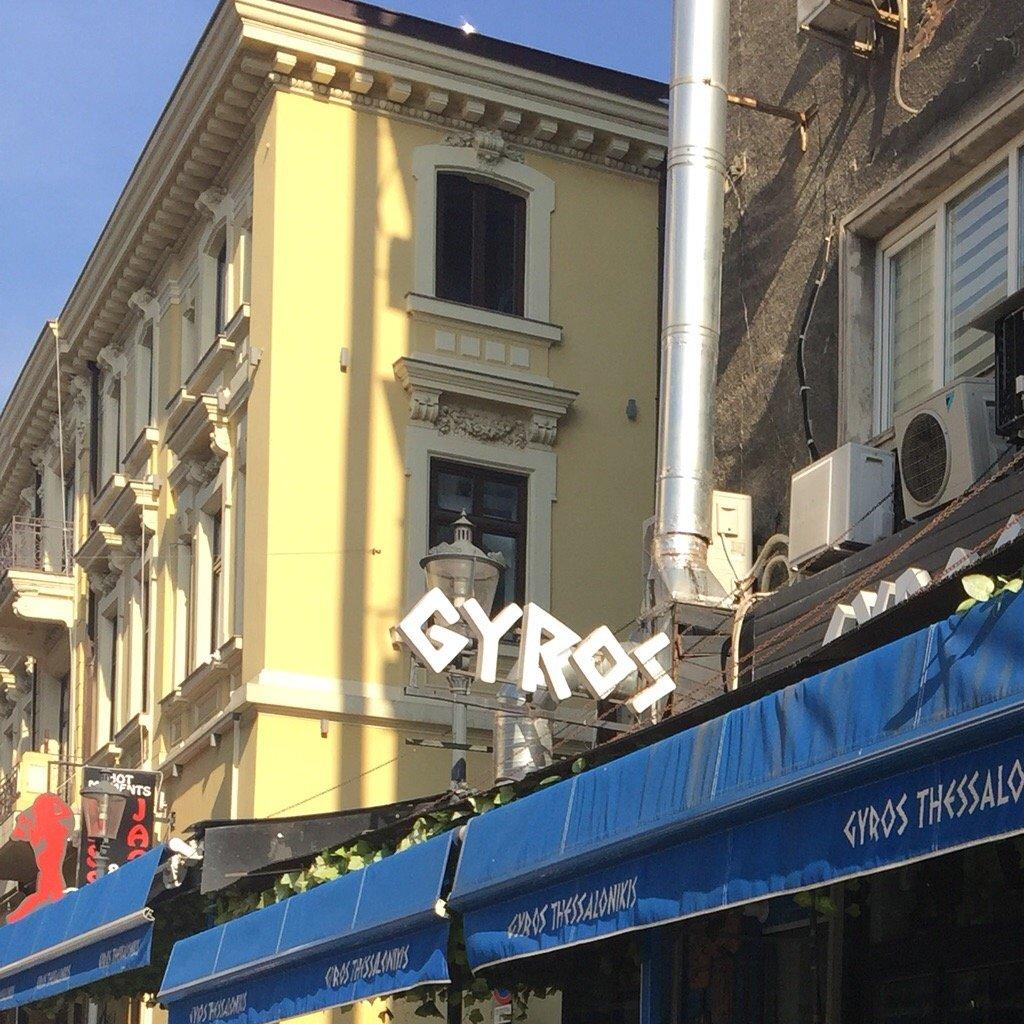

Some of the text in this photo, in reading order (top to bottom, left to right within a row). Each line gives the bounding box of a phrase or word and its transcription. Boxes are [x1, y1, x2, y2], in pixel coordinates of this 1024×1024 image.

[397, 586, 677, 714] GYROS
[843, 792, 909, 848] GYROS
[507, 875, 638, 939] GYROS THESSALONIKIS
